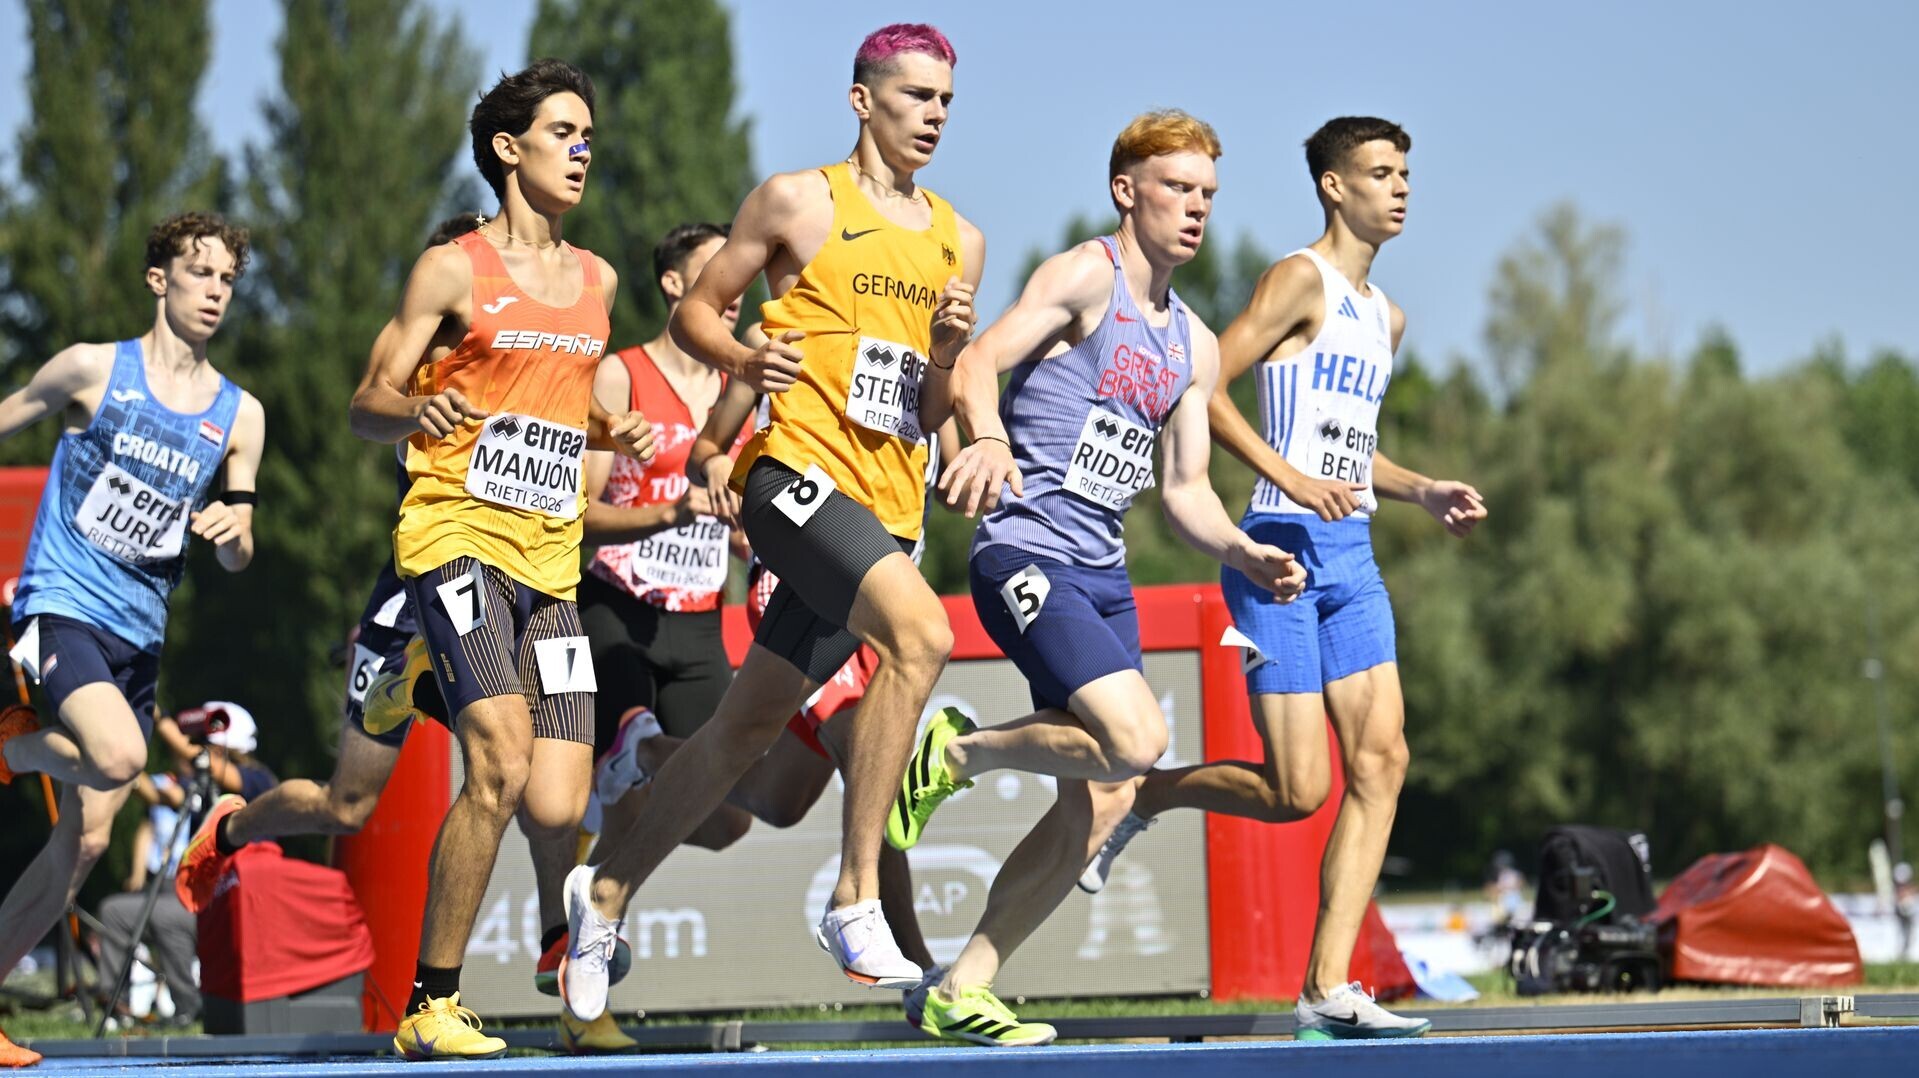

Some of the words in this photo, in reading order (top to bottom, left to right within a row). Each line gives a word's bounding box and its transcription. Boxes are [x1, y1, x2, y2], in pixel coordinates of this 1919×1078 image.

[853, 273, 938, 310] GERMAN
[491, 330, 605, 358] ESPAÑA
[1113, 344, 1180, 399] GREAT
[1311, 352, 1390, 405] HELLA
[113, 433, 200, 484] CROATIA
[473, 444, 578, 493] MANJÓN
[485, 481, 528, 505] RIETI
[530, 492, 563, 513] 2026
[787, 475, 819, 506] 8
[1080, 476, 1114, 503] RIETI
[455, 580, 481, 623] 7
[1013, 580, 1040, 617] 5
[354, 658, 370, 693] 6
[915, 880, 969, 917] AP
